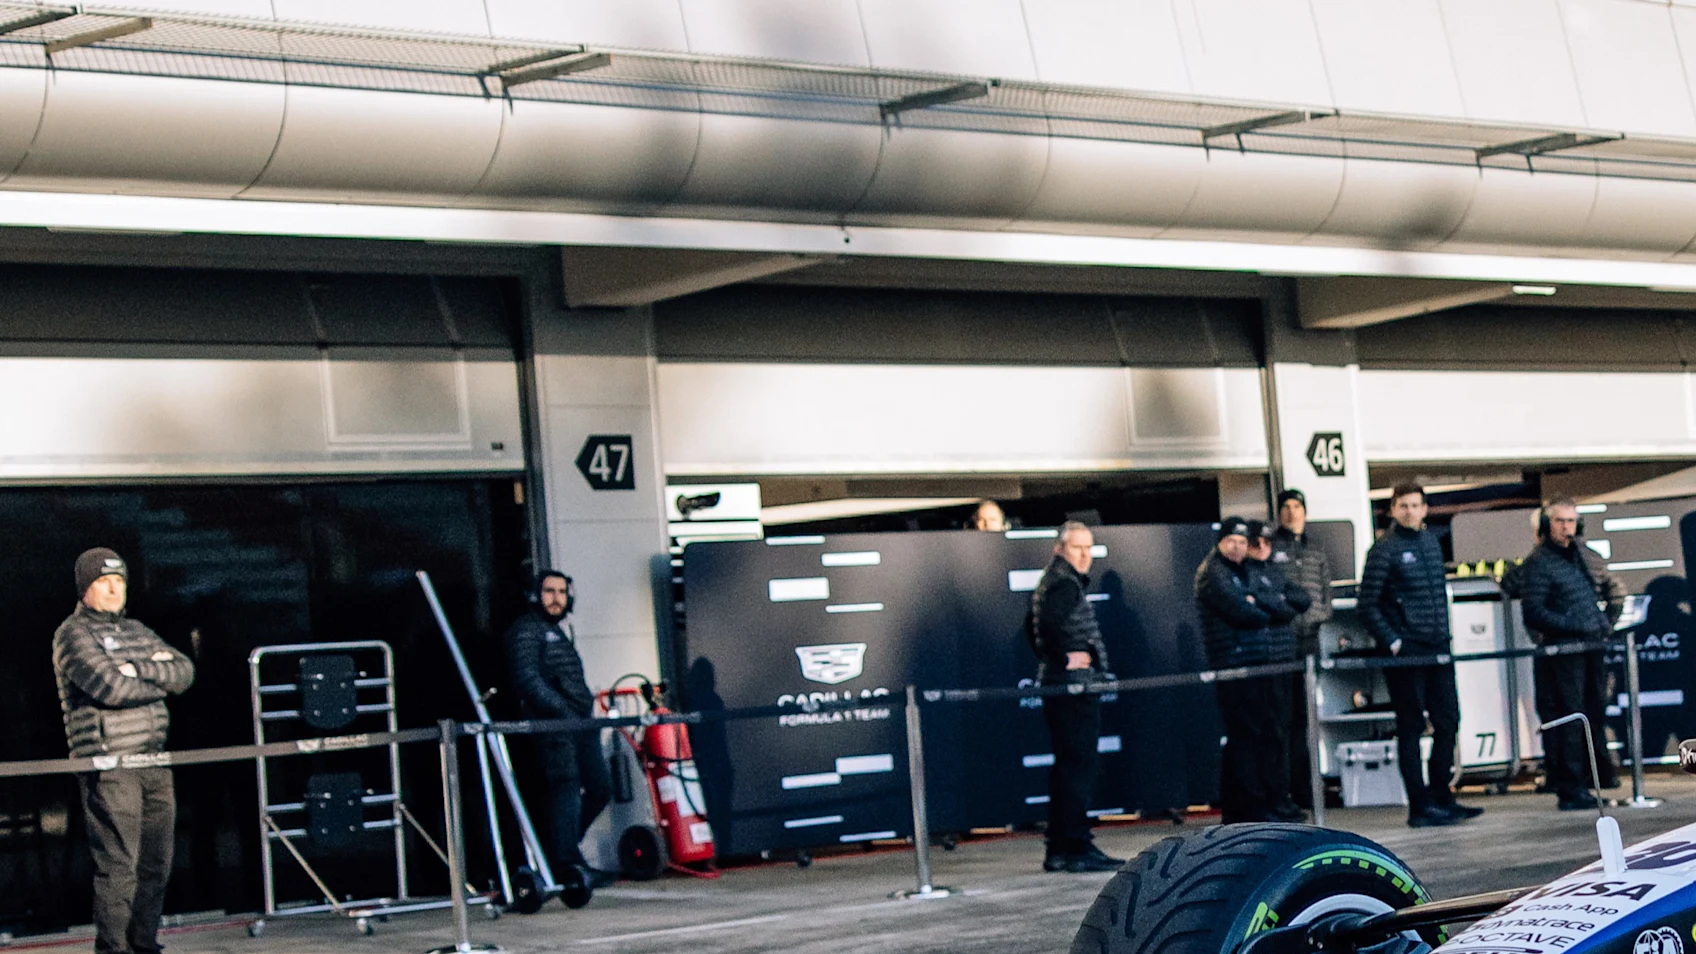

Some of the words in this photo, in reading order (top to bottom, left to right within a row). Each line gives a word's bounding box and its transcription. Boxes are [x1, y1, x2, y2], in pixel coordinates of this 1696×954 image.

[588, 444, 630, 482] 47
[1312, 437, 1343, 472] 46
[779, 711, 843, 726] FORMULA
[853, 708, 890, 721] TEAM
[1475, 732, 1497, 759] 77
[1528, 880, 1656, 902] VISA
[1523, 902, 1573, 913] Cash
[1576, 903, 1619, 916] App
[1478, 916, 1595, 932] dynatrace
